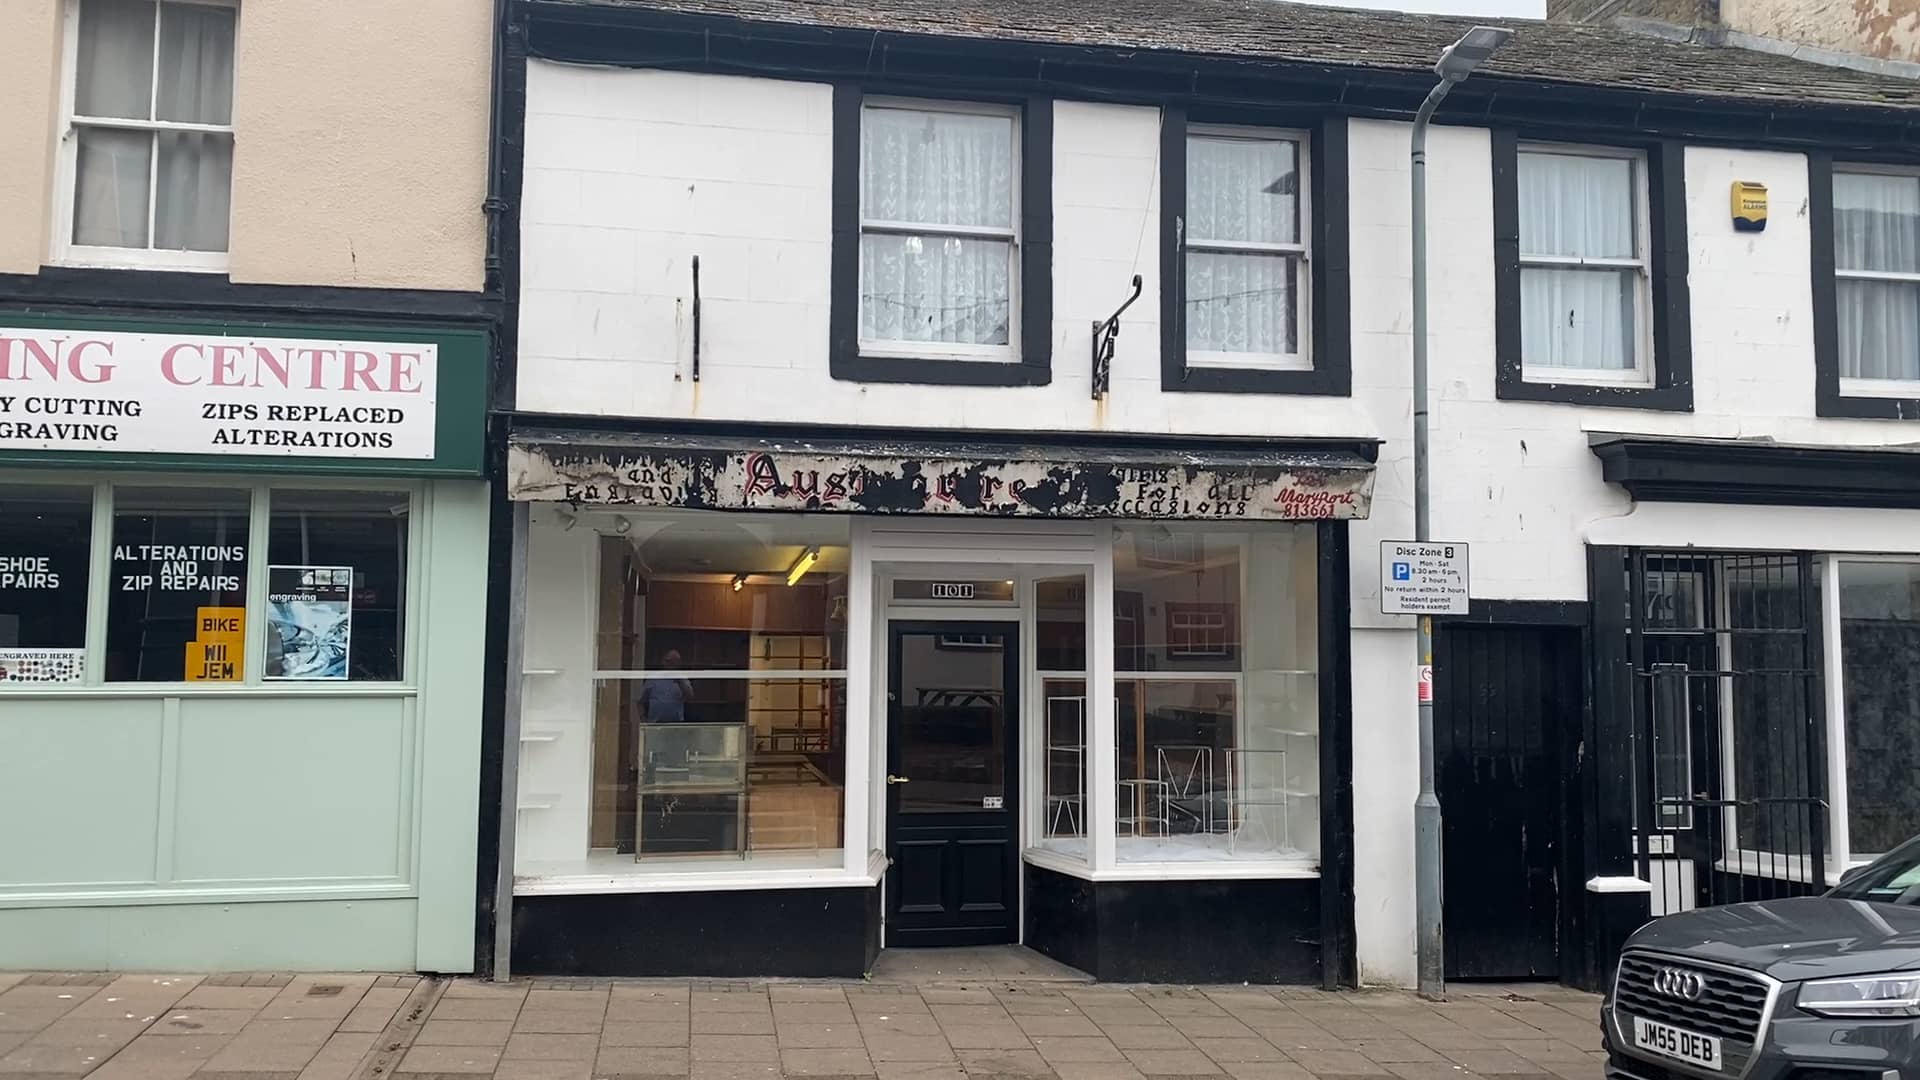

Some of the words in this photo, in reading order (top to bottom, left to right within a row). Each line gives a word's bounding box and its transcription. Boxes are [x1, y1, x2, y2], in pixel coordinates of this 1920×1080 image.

[0, 338, 117, 384] ING
[161, 343, 423, 394] CENTRE
[25, 397, 142, 417] CUTTING
[202, 403, 258, 420] ZIPS
[267, 405, 404, 424] REPLACED
[0, 422, 119, 442] GRAVING
[212, 428, 393, 449] ALTERATIONS
[1285, 502, 1335, 518] 813661
[114, 545, 244, 561] ALTERATIONS
[1396, 546, 1417, 556] Disc
[1419, 547, 1442, 556] Zone
[0, 557, 50, 572] SHOE
[160, 561, 198, 576] AND
[1396, 564, 1407, 579] P
[122, 575, 153, 591] ZIP
[161, 575, 240, 591] REPAIRS
[935, 585, 971, 597] 101
[269, 593, 317, 602] engraving
[202, 618, 240, 632] BIKE
[49, 652, 75, 660] HERE
[196, 662, 234, 679] JEM
[1640, 1022, 1677, 1052] JM55
[1680, 1031, 1713, 1062] DEB
